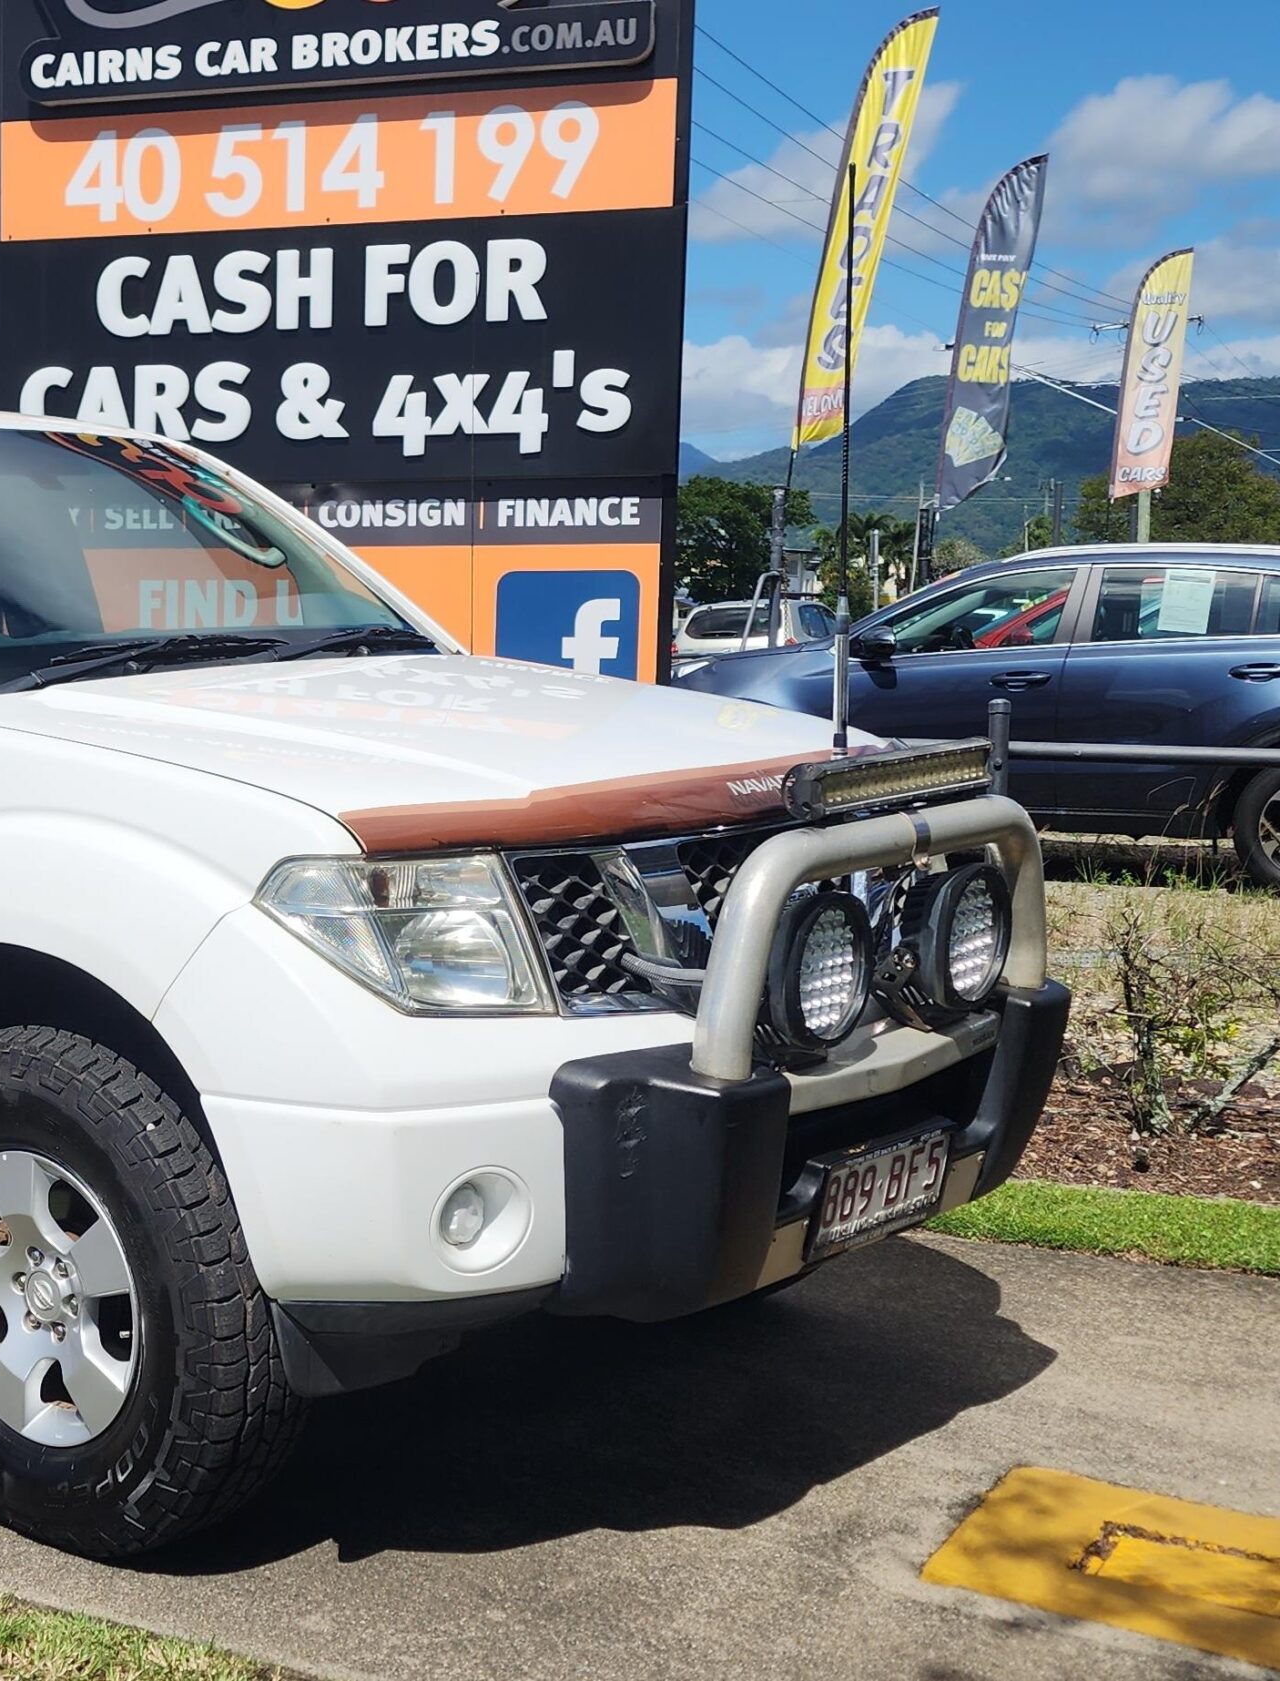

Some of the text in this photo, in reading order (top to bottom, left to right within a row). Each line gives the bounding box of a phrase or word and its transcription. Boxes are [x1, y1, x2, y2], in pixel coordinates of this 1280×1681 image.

[30, 43, 182, 89] CAIRNS
[195, 37, 277, 77] CAR
[64, 101, 600, 222] 40 514 199
[96, 238, 548, 339] CASH FOR
[19, 360, 251, 442] CARS
[275, 361, 349, 440] &
[1125, 310, 1179, 457] USED
[1118, 465, 1166, 483] CARS
[104, 503, 174, 530] SELL
[318, 498, 466, 529] CONSIGN
[497, 496, 641, 528] FINANCE
[138, 579, 304, 629] FIND U
